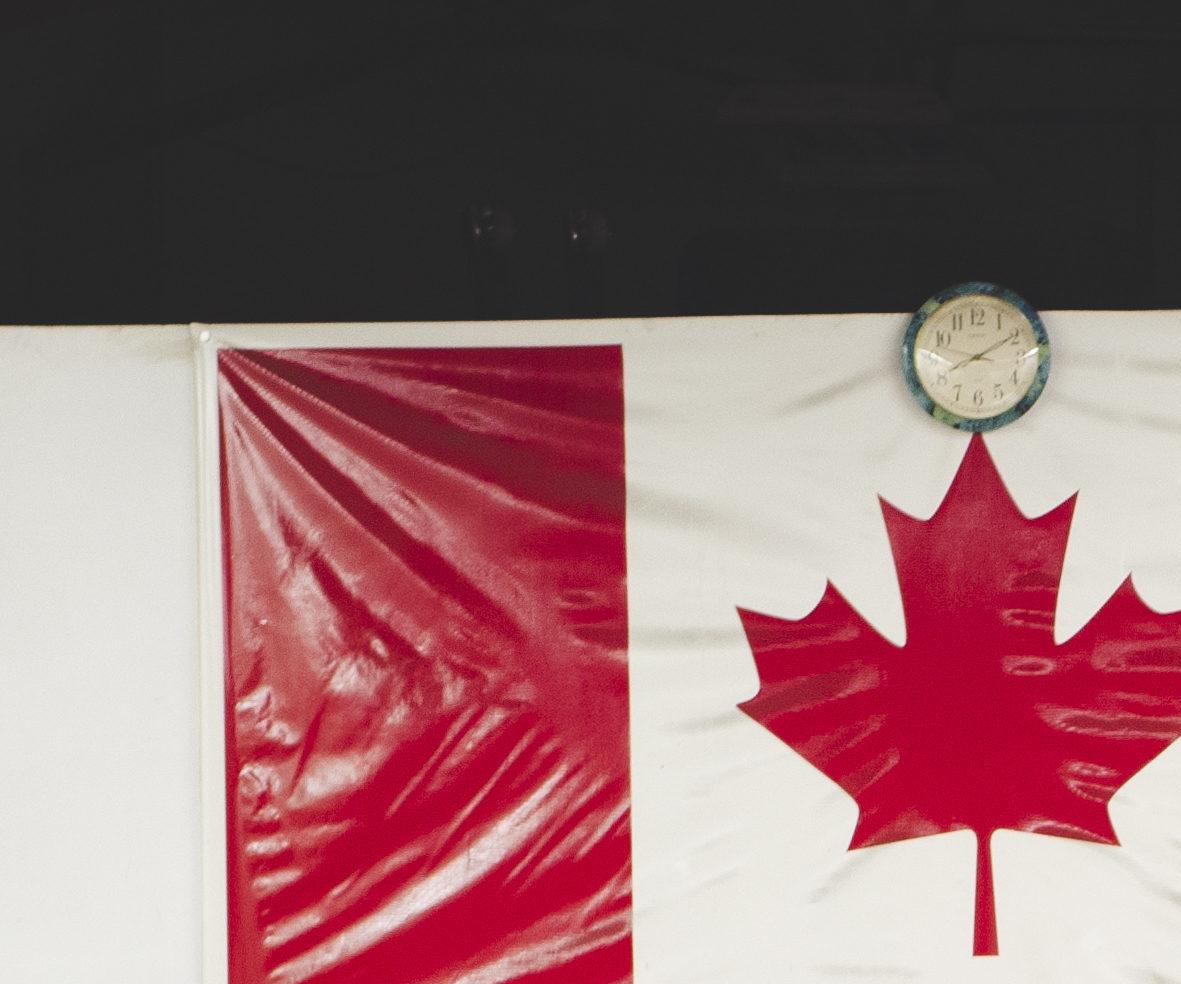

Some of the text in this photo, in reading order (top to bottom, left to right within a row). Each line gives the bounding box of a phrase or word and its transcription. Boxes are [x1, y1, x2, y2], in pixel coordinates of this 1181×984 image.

[952, 313, 963, 331] 11
[970, 308, 985, 326] 12
[936, 330, 951, 347] 10
[1010, 328, 1020, 345] 2
[1009, 369, 1018, 385] 4
[952, 384, 962, 402] 7
[972, 389, 984, 406] 6
[993, 383, 1004, 400] 5
